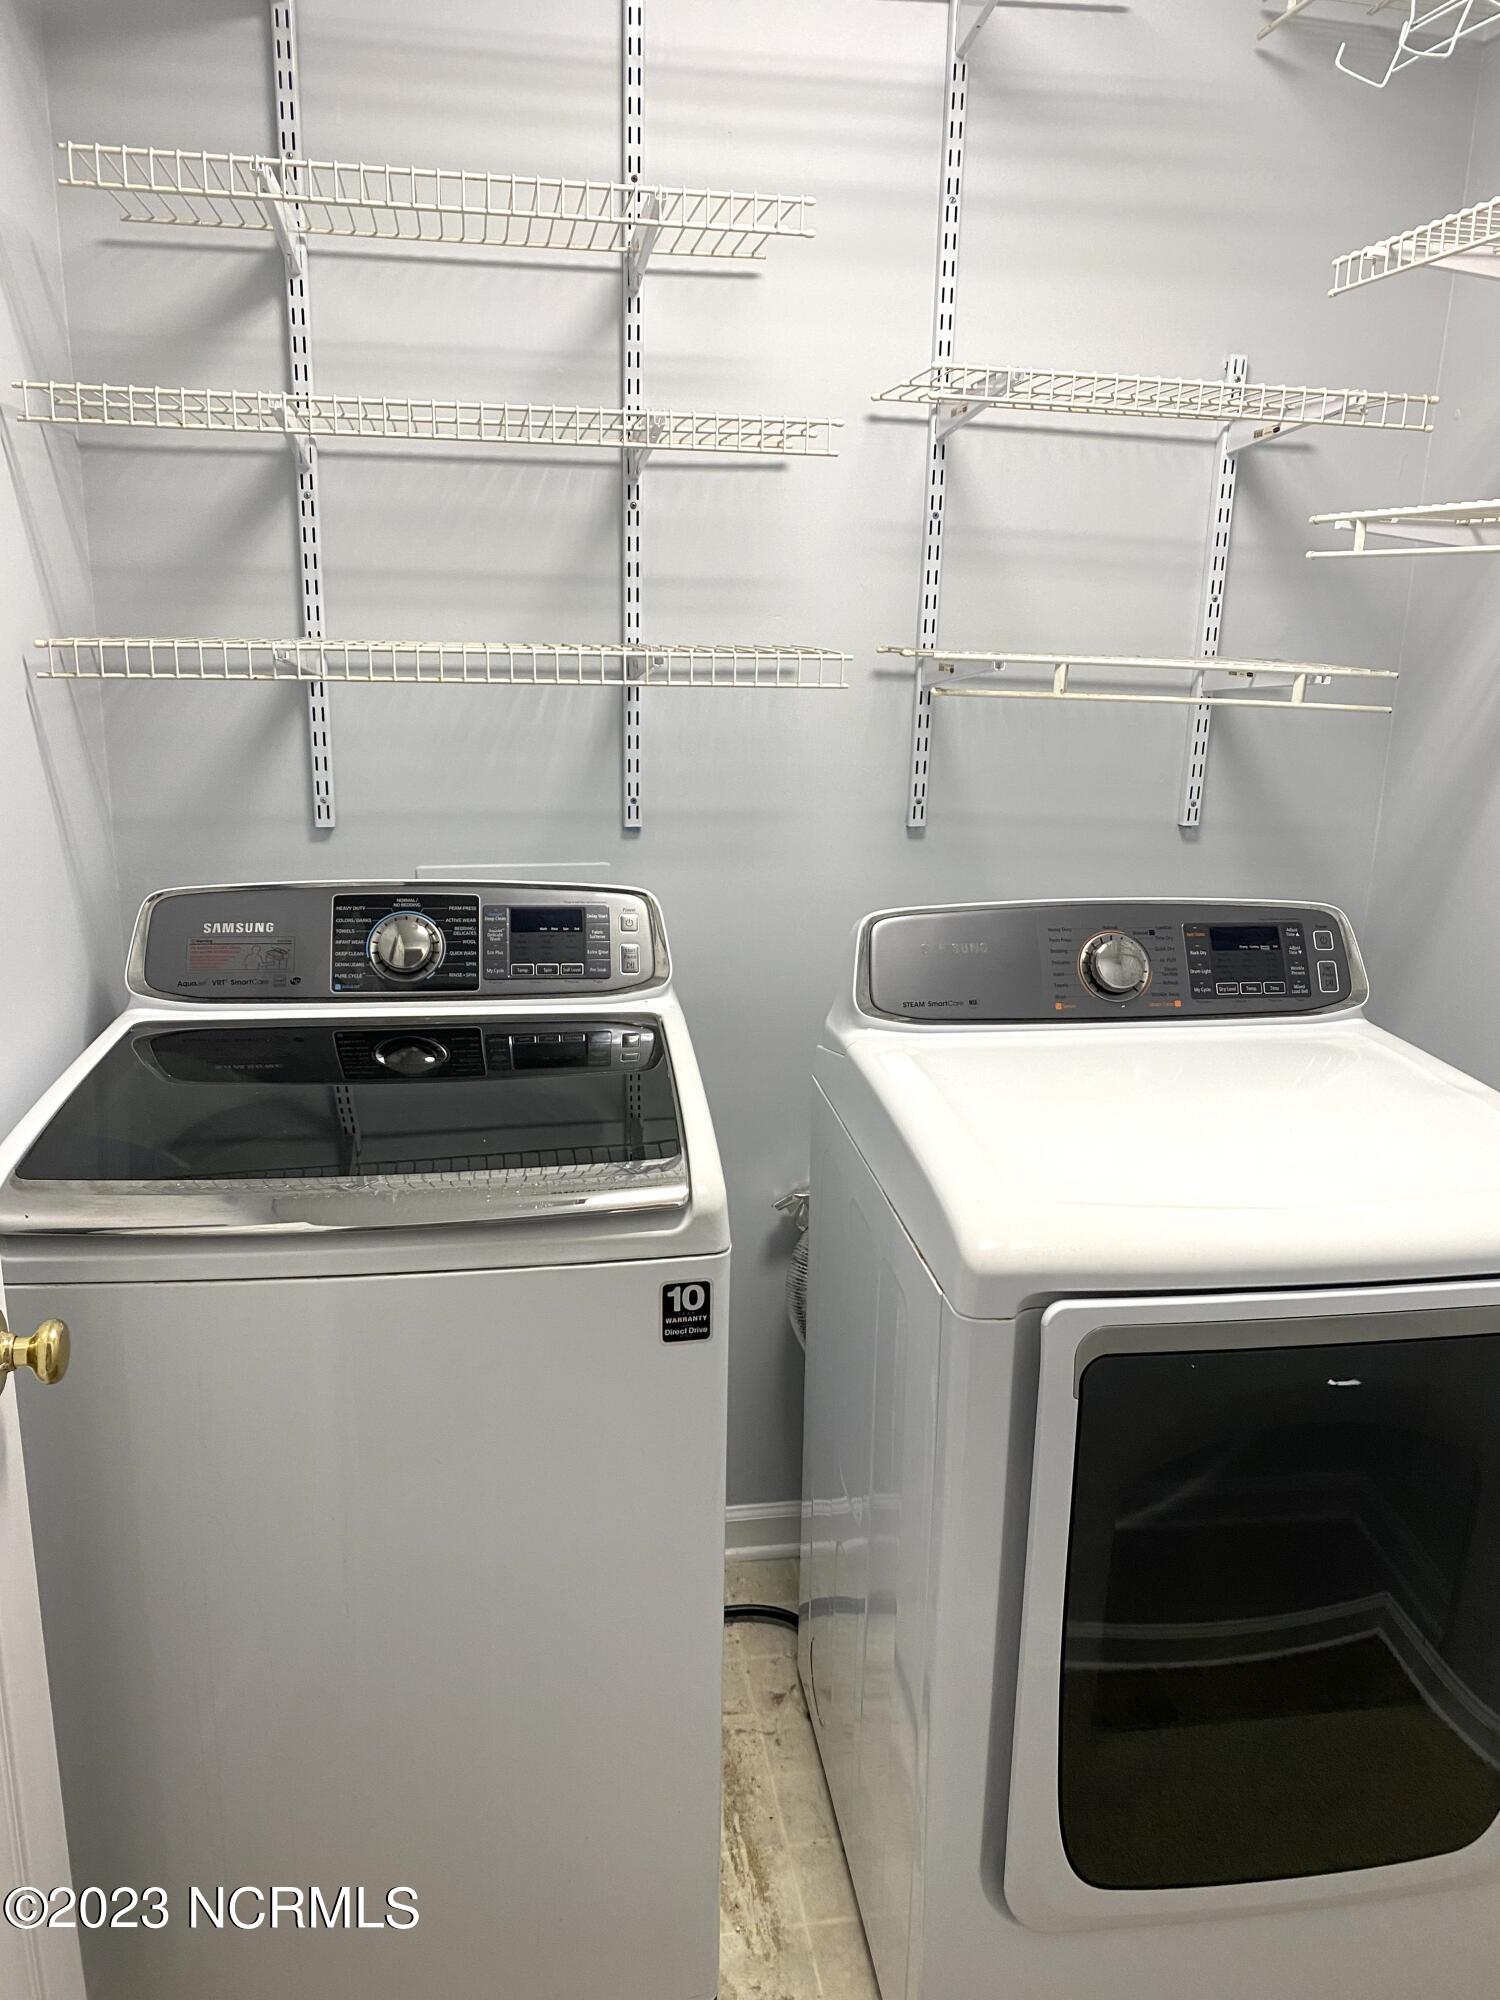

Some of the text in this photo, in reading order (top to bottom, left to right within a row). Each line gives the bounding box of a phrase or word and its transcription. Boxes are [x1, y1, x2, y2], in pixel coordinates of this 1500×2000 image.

[203, 922, 275, 934] SAMSUNG
[921, 943, 988, 954] SSUNG
[211, 978, 226, 986] VRT
[928, 1000, 964, 1008] SmartCare
[667, 1284, 705, 1312] 10
[665, 1315, 707, 1324] WARRANTY
[664, 1326, 708, 1336] Direct Drive
